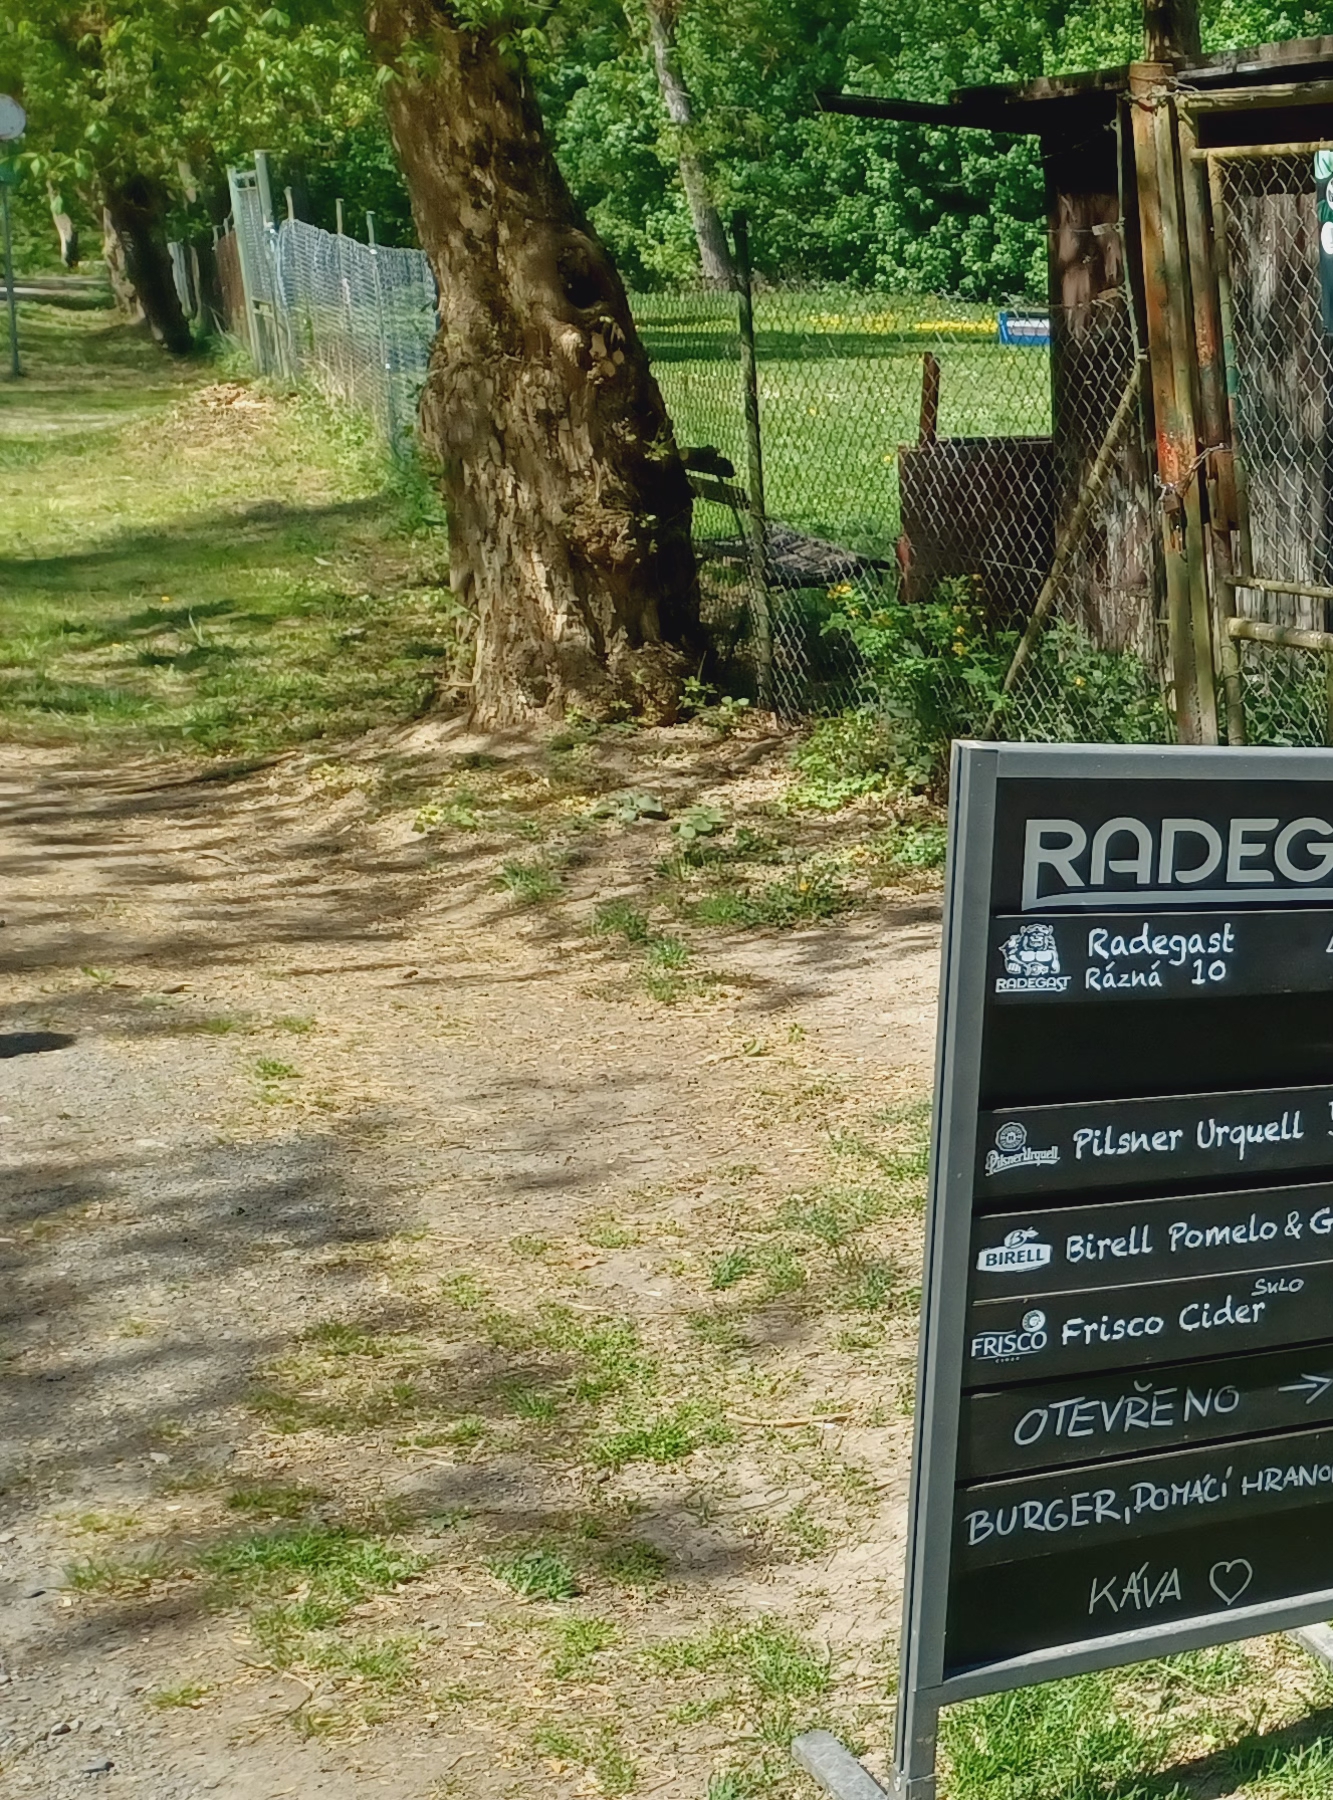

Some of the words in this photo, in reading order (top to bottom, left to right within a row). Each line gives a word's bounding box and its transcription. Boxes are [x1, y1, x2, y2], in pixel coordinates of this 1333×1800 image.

[1088, 922, 1235, 966] Radegast
[996, 976, 1072, 993] RADEGAST
[1085, 960, 1163, 991] Rázná
[1191, 959, 1227, 985] 10
[1073, 1125, 1184, 1159] Pilsner
[1196, 1110, 1304, 1160] Urquell
[985, 1248, 1044, 1267] BIRELL
[1066, 1225, 1152, 1263] Birell
[1168, 1213, 1278, 1252] Pomelo
[1284, 1211, 1303, 1239] &
[971, 1331, 1048, 1357] FRISCO
[1061, 1315, 1164, 1346] Frisco
[1178, 1296, 1266, 1333] Cider
[1013, 1380, 1240, 1446] OTEVŘENO
[963, 1488, 1132, 1546] BURGER,
[1088, 1561, 1182, 1614] KÁVA
